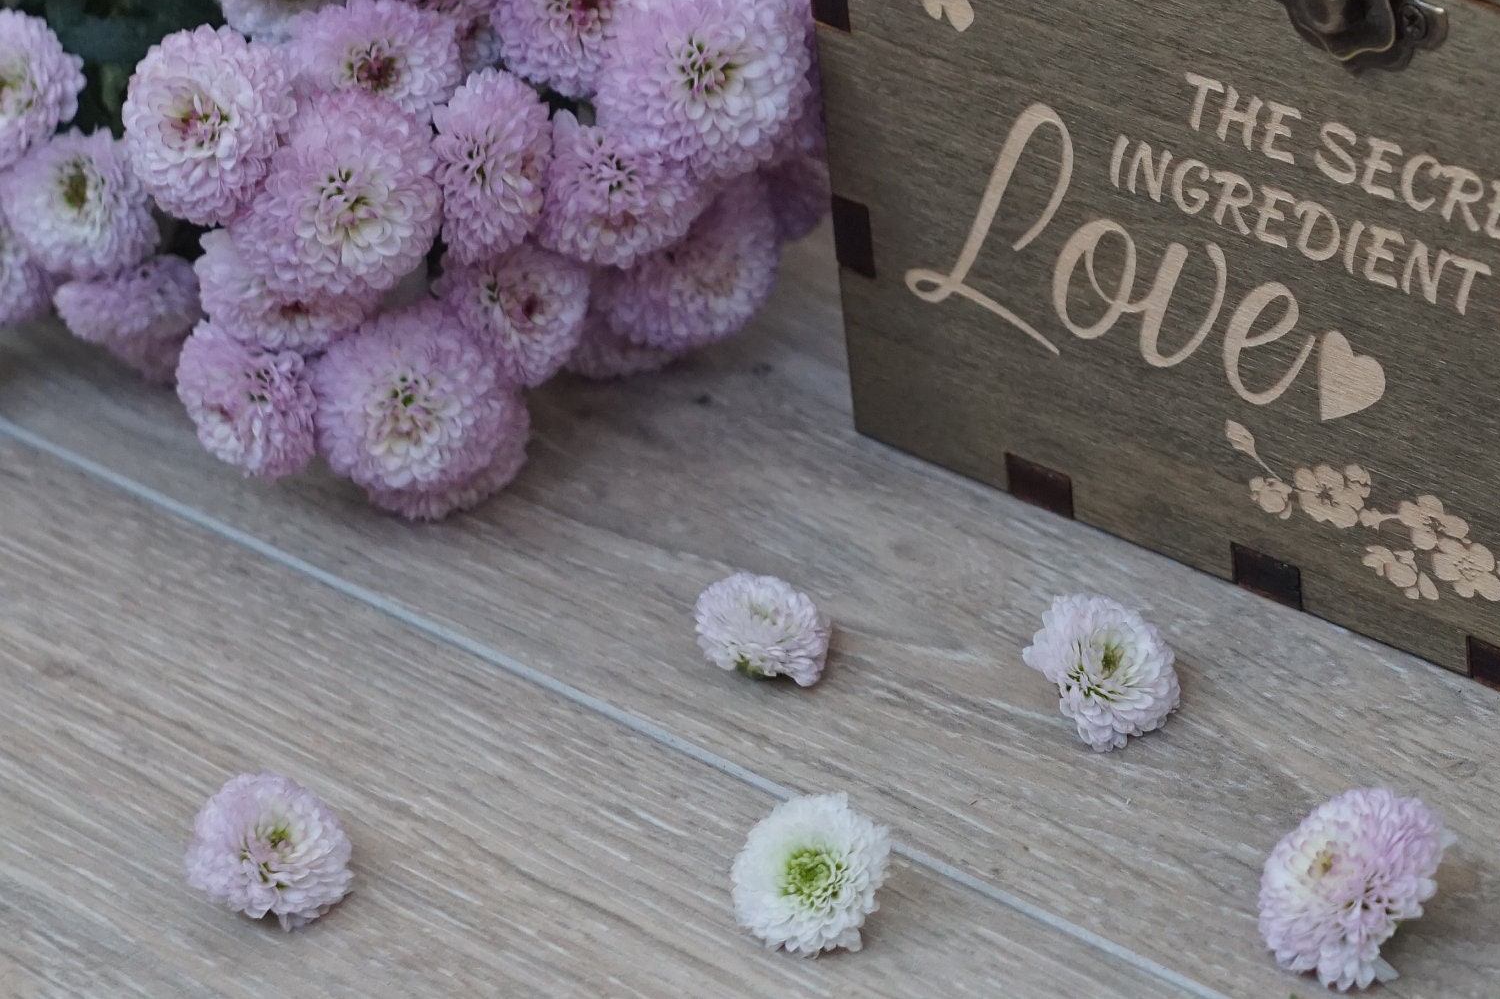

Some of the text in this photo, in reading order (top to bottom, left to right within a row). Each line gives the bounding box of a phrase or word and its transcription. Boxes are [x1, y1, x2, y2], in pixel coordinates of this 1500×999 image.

[1184, 72, 1302, 164] THE
[904, 102, 1317, 405] Love
[1109, 134, 1492, 315] INGREDIENT
